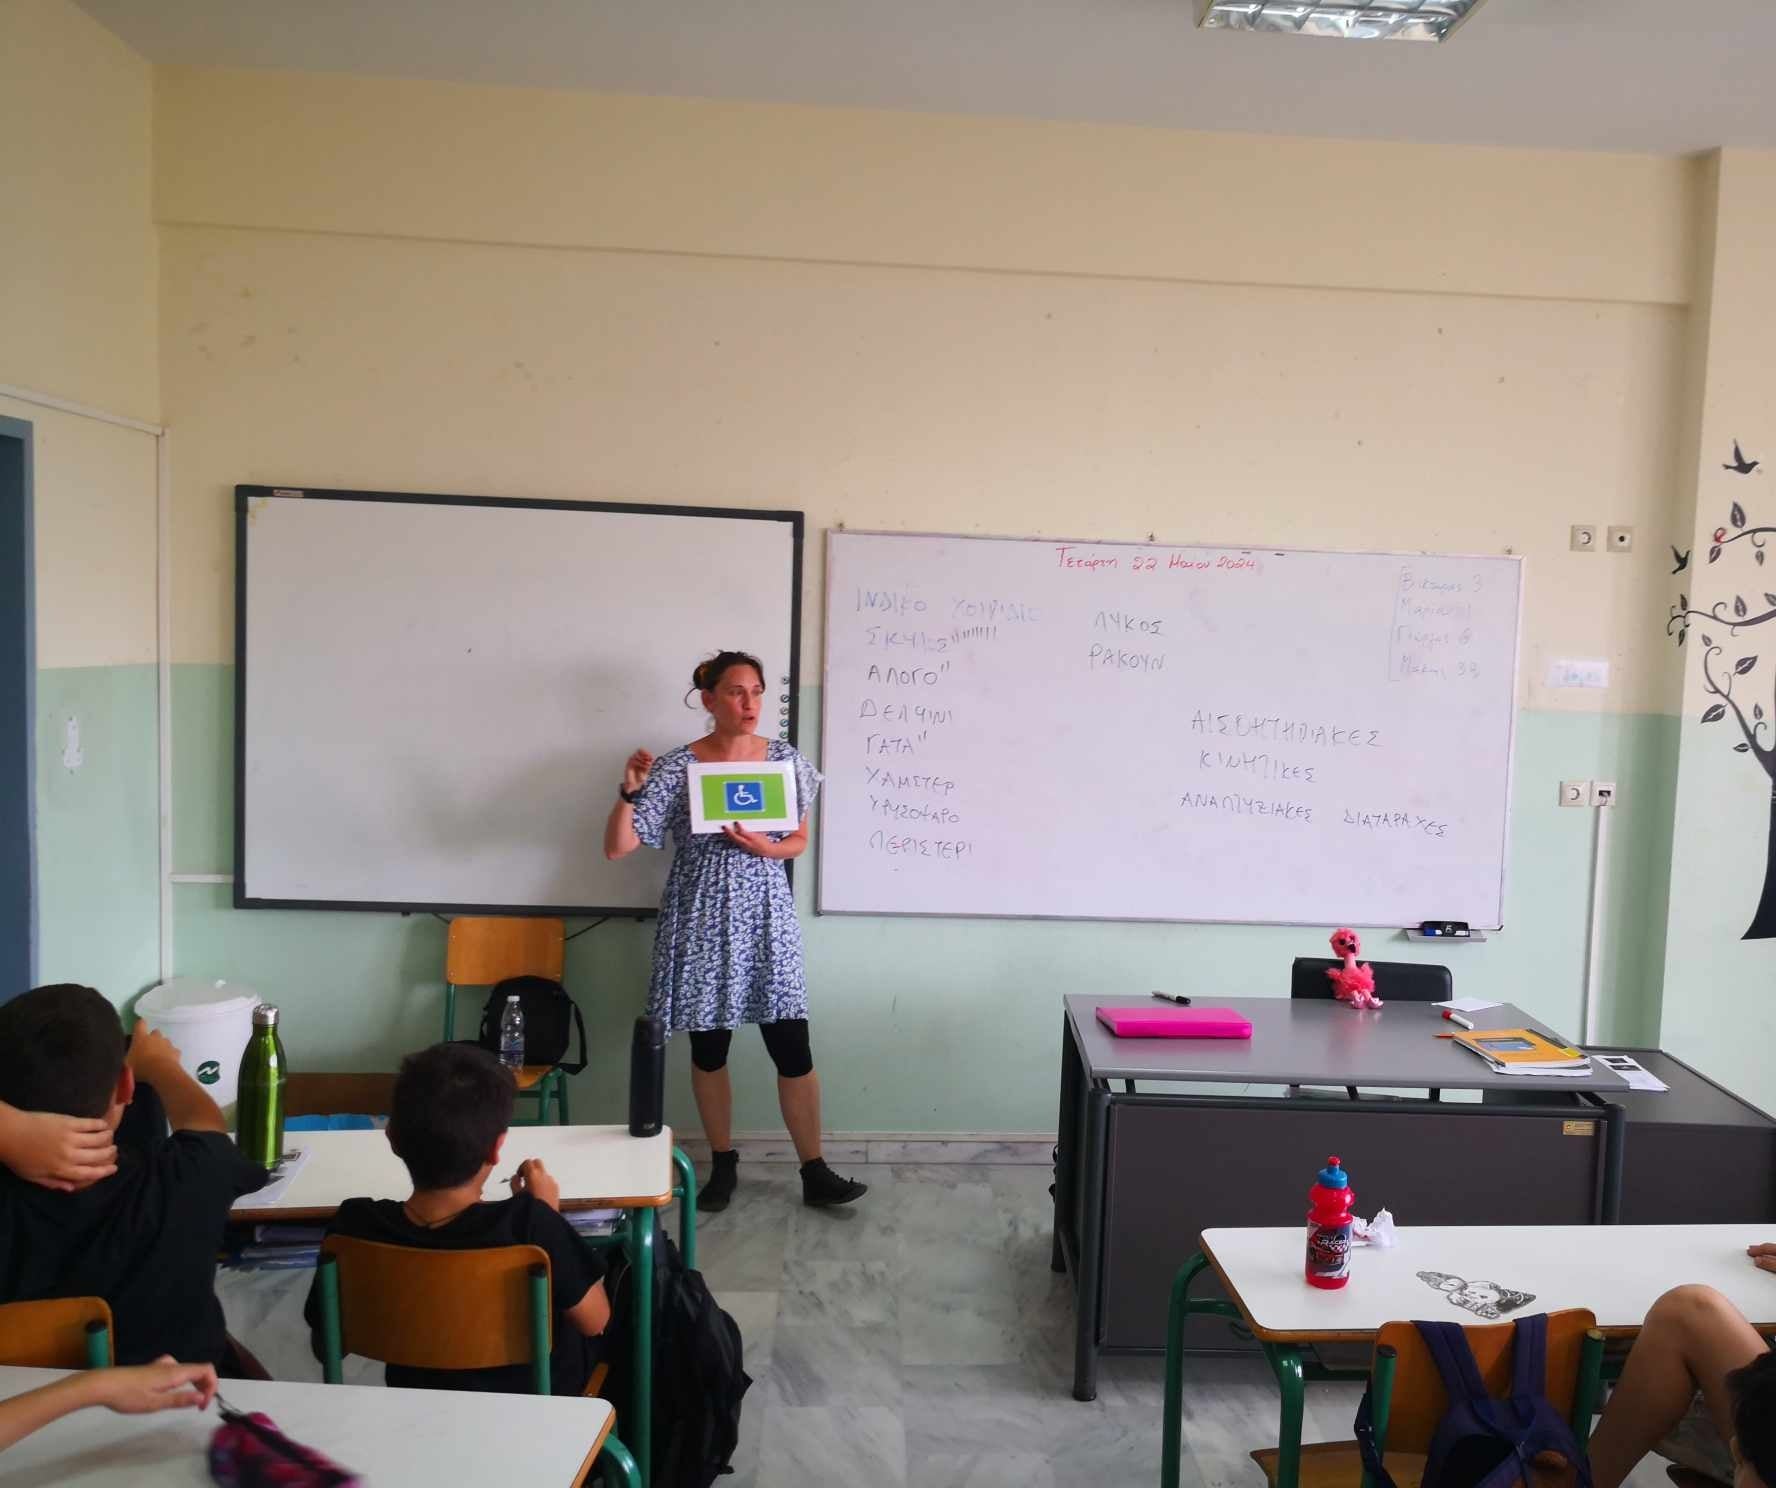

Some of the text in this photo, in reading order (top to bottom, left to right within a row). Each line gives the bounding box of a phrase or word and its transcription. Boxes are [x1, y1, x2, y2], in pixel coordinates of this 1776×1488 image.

[1131, 556, 1158, 570] 22
[1217, 555, 1257, 571] 2024
[1093, 610, 1165, 636] ΛΥΚΟΣ
[1088, 642, 1165, 672] ΡΑΚΟΥΝ
[865, 765, 955, 796] ΧΑΜΣΤΕΡ
[869, 829, 973, 861] ΠΕΡΙΣΤΕΡΙ
